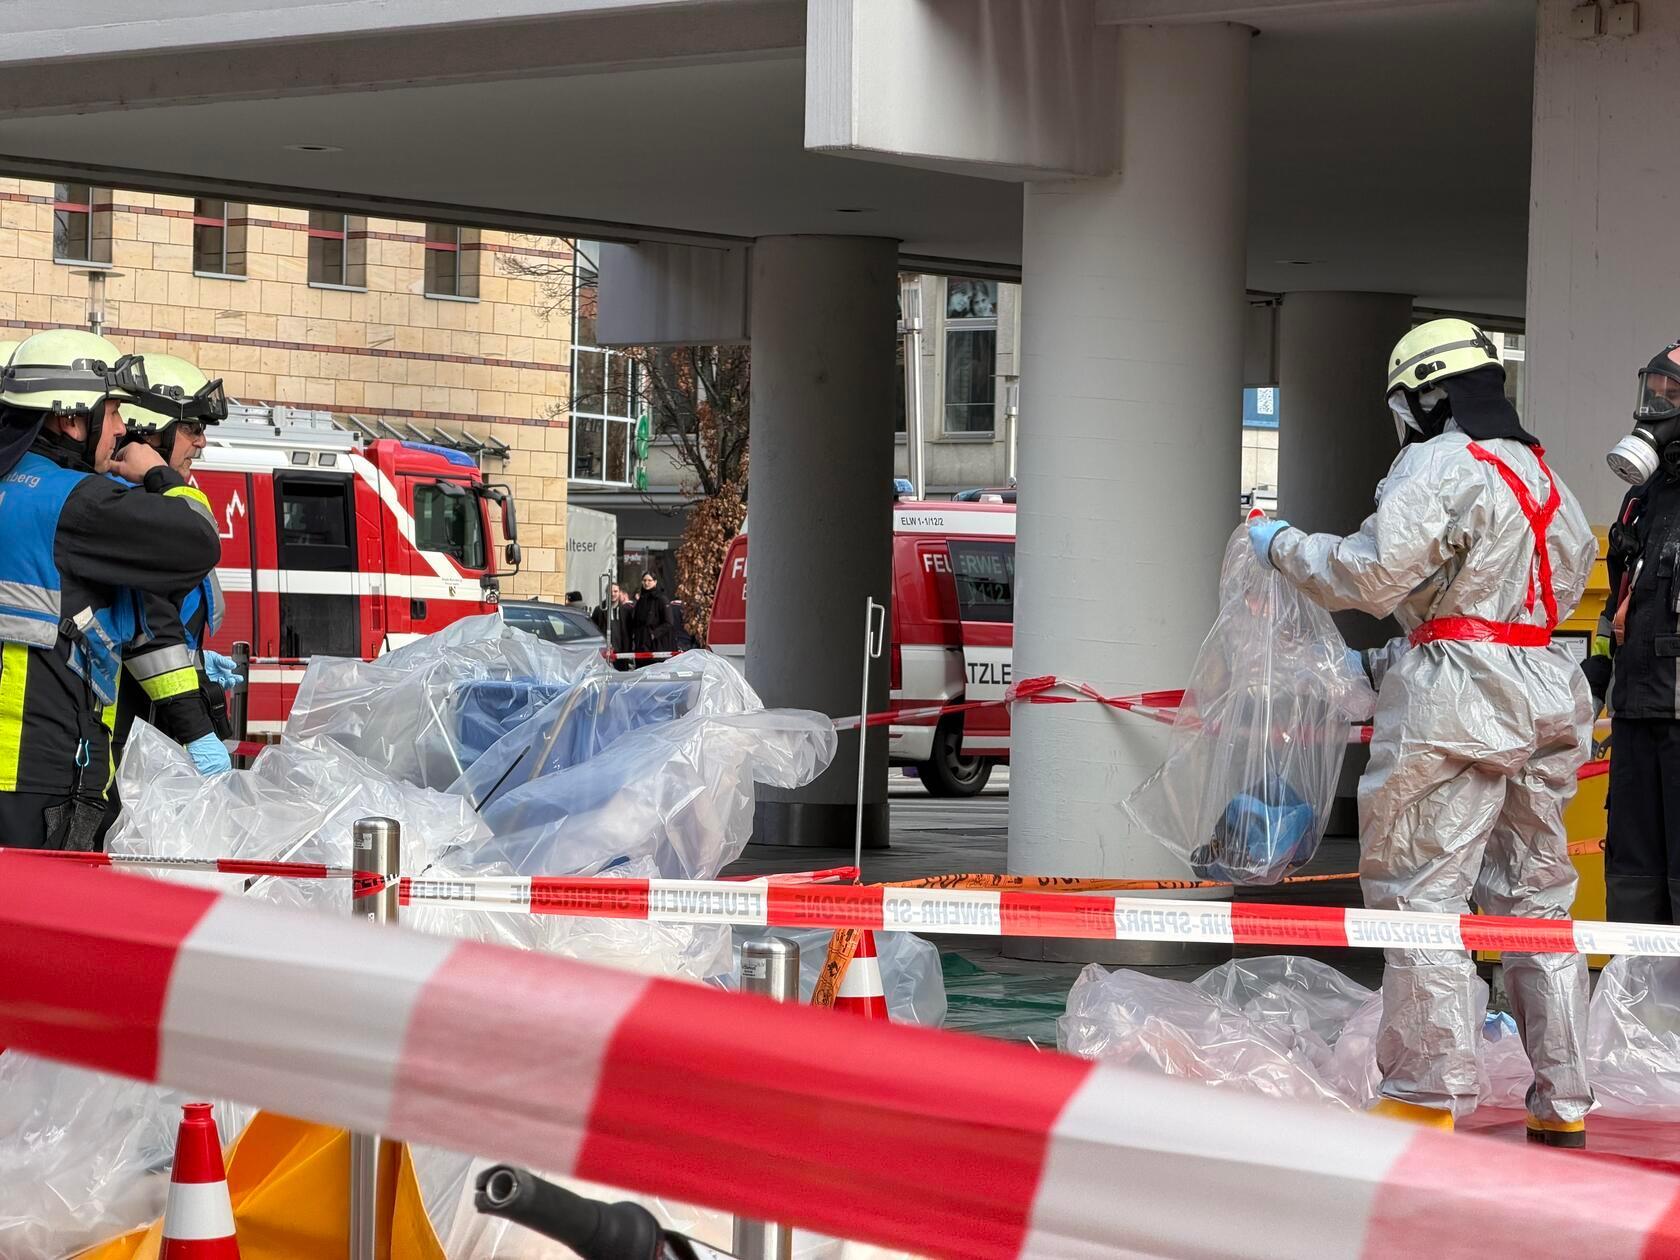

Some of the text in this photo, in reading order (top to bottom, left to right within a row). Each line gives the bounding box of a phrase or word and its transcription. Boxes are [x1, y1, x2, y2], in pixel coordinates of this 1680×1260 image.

[81, 359, 87, 370] 1
[1431, 361, 1438, 371] 1
[159, 385, 165, 395] 1
[7, 472, 40, 488] berg
[900, 516, 917, 526] ELW
[566, 538, 597, 552] lteser
[963, 662, 1012, 685] TZLE
